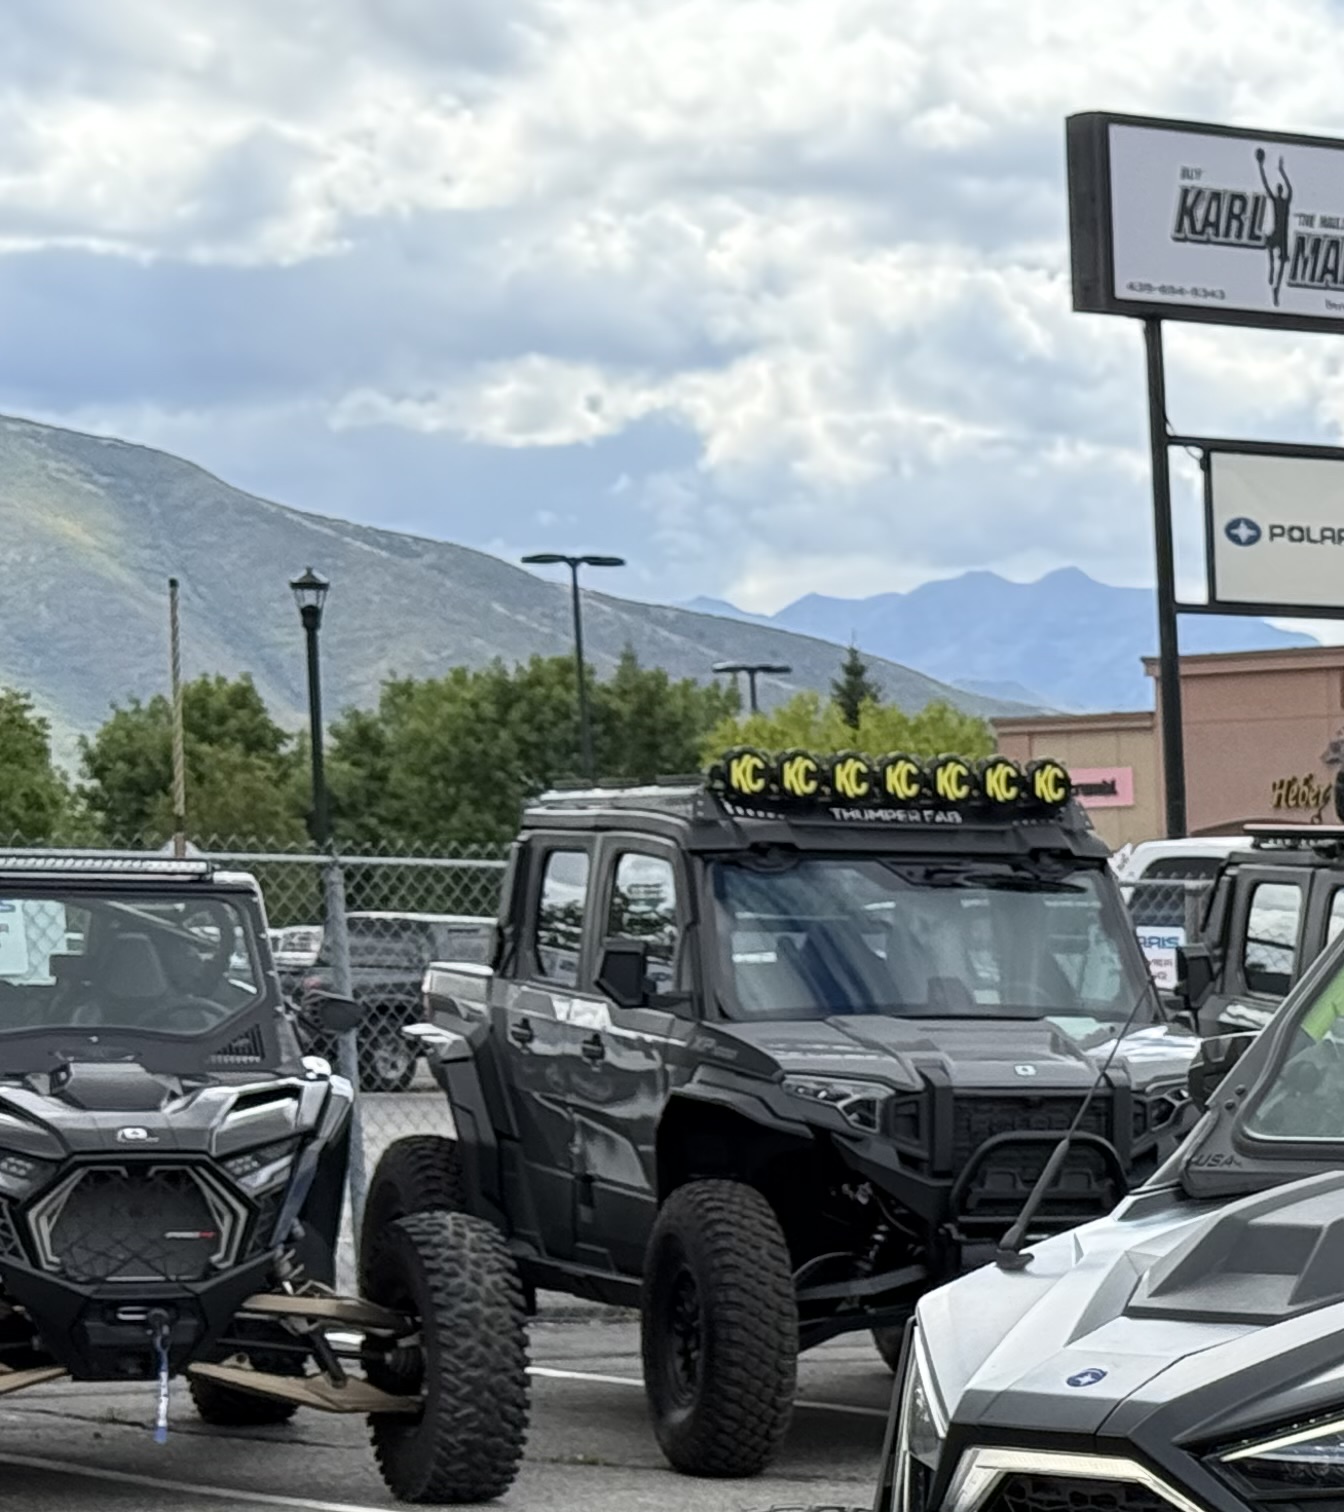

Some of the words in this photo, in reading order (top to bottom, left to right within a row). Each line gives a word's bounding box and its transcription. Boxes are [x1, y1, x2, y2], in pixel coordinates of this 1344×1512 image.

[1173, 186, 1266, 247] KARL
[731, 754, 765, 794] KC
[783, 756, 817, 796] KC
[835, 758, 869, 798] KC
[886, 760, 920, 800] KC
[936, 761, 970, 801] KC
[986, 762, 1019, 802] KC
[1035, 764, 1066, 803] KC
[829, 807, 921, 822] THUMPER
